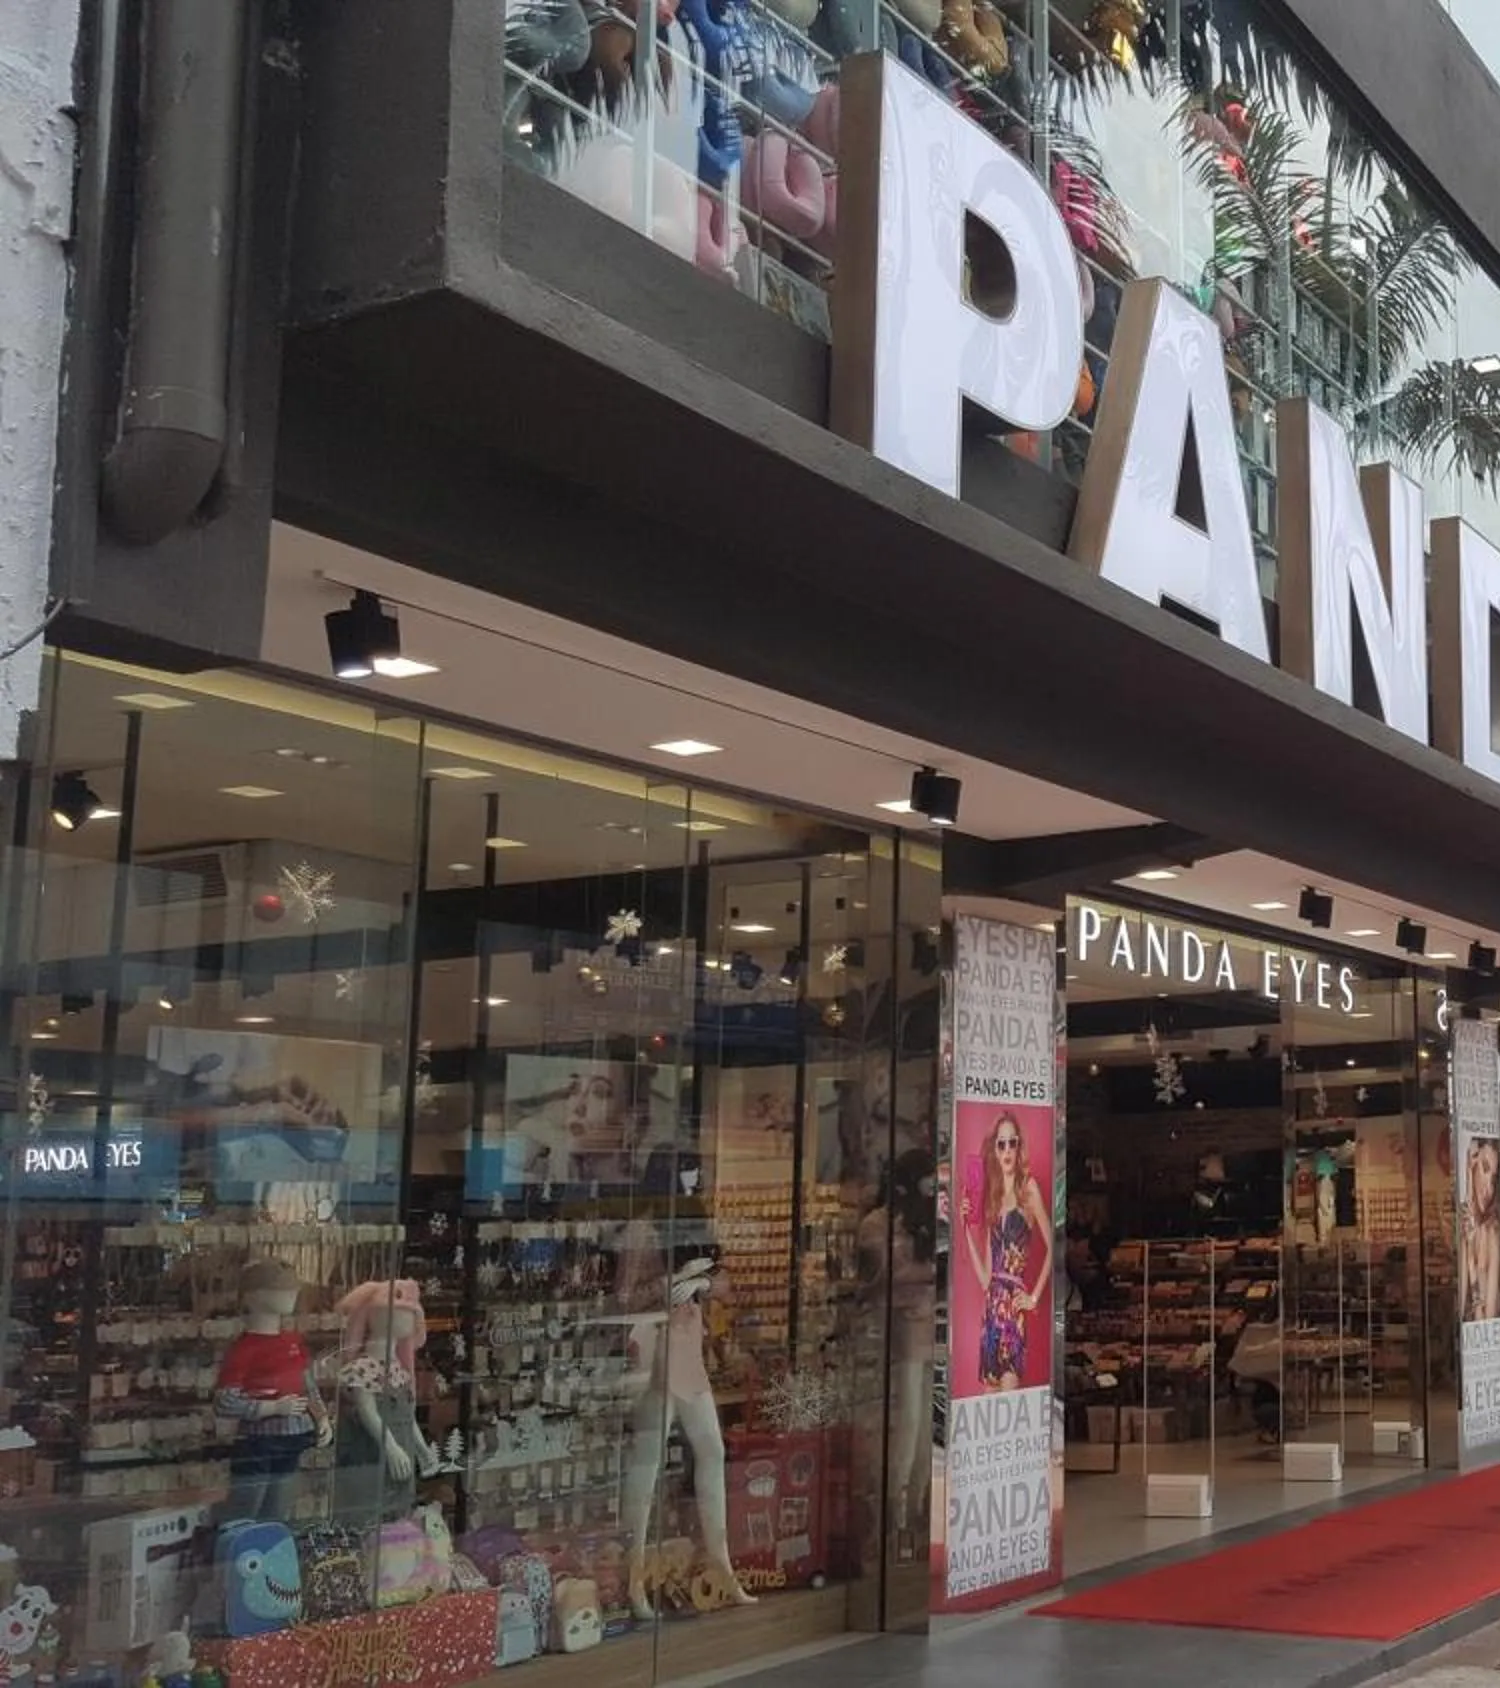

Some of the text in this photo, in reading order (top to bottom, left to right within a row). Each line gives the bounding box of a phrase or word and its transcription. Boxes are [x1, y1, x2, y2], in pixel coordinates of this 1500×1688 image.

[959, 957, 1025, 993] PANDA
[1079, 905, 1354, 1013] PANDA EYES
[957, 1009, 1040, 1051] PANDA
[965, 1075, 1011, 1098] PANDA
[1013, 1080, 1047, 1100] EYES
[25, 1146, 89, 1172] PANDA
[976, 1438, 1011, 1466] EYES
[949, 1474, 1050, 1542] PANDA
[999, 1529, 1038, 1562] EYES
